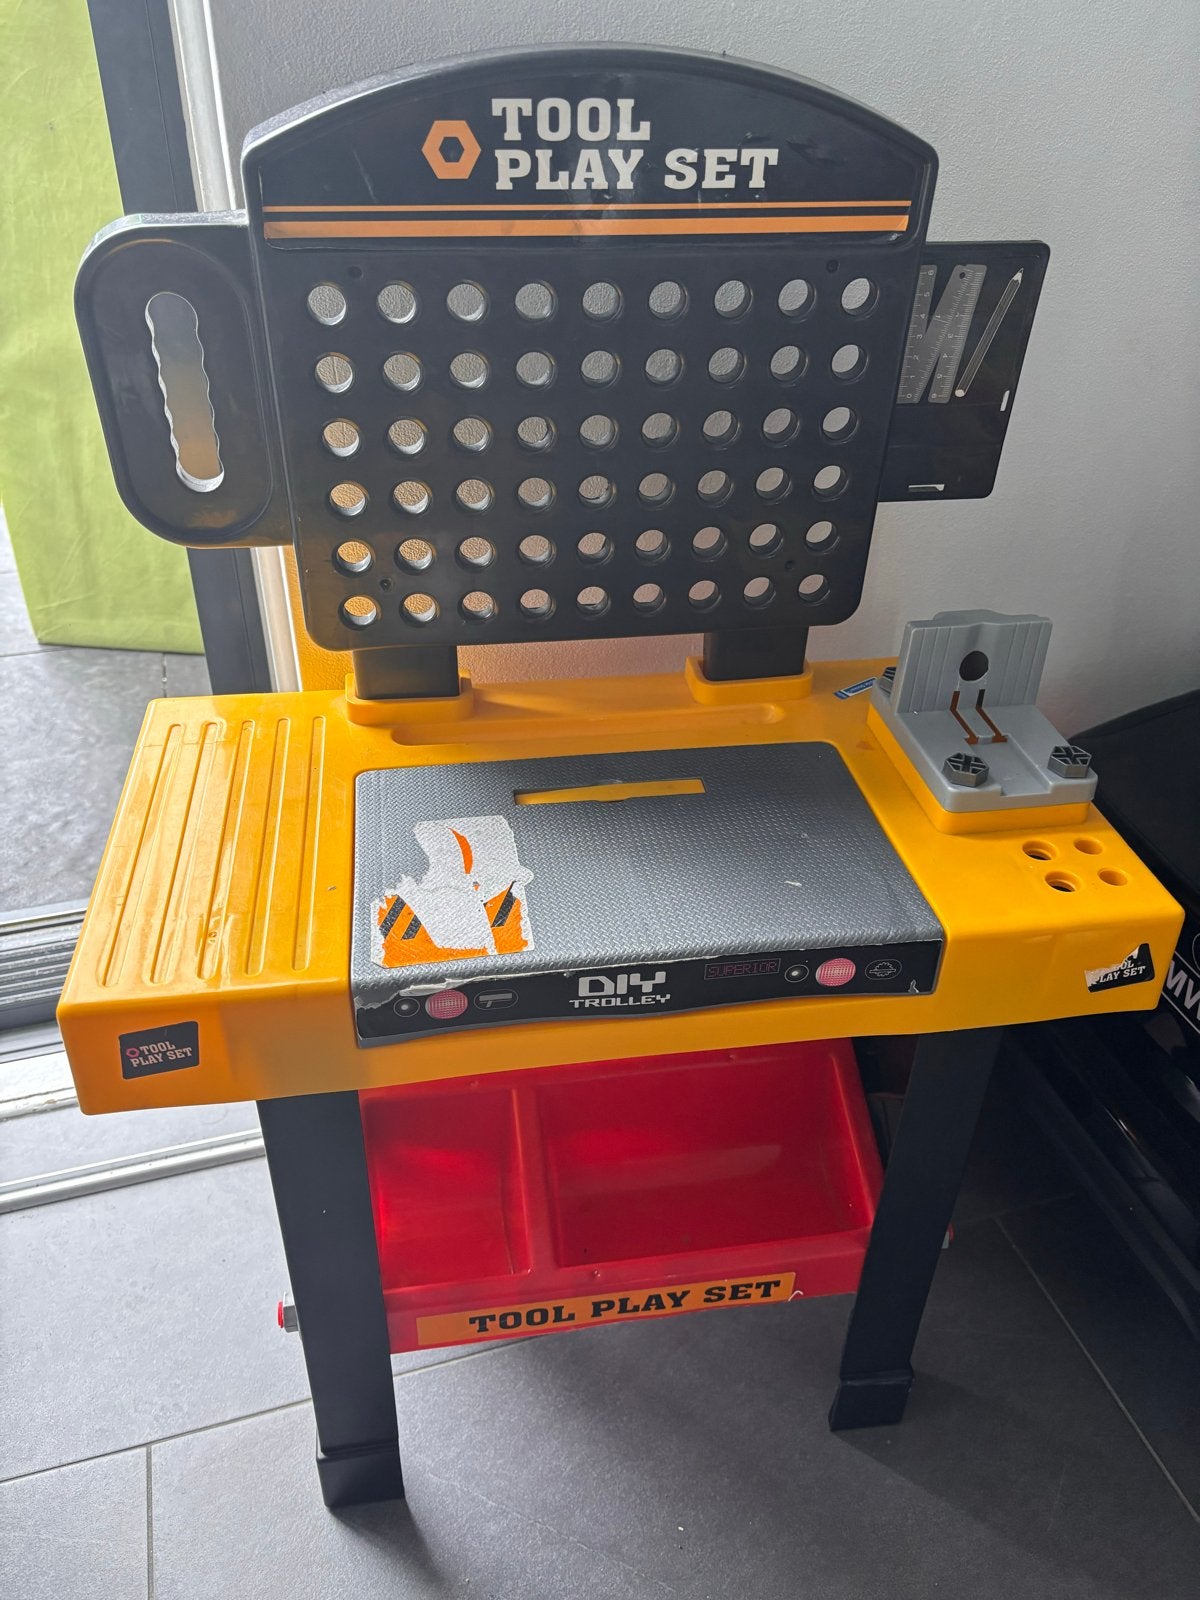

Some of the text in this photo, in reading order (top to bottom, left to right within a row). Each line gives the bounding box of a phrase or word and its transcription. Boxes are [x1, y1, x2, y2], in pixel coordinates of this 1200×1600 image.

[491, 98, 651, 142] TOOL
[494, 147, 779, 191] PLAY SET
[578, 971, 666, 997] DIY
[1099, 966, 1146, 983] LAY SET
[569, 994, 671, 1009] TROLLEY
[130, 1047, 193, 1068] PLAY SET
[140, 1041, 176, 1056] TOOL
[469, 1280, 781, 1333] TOOL PLAY SET
